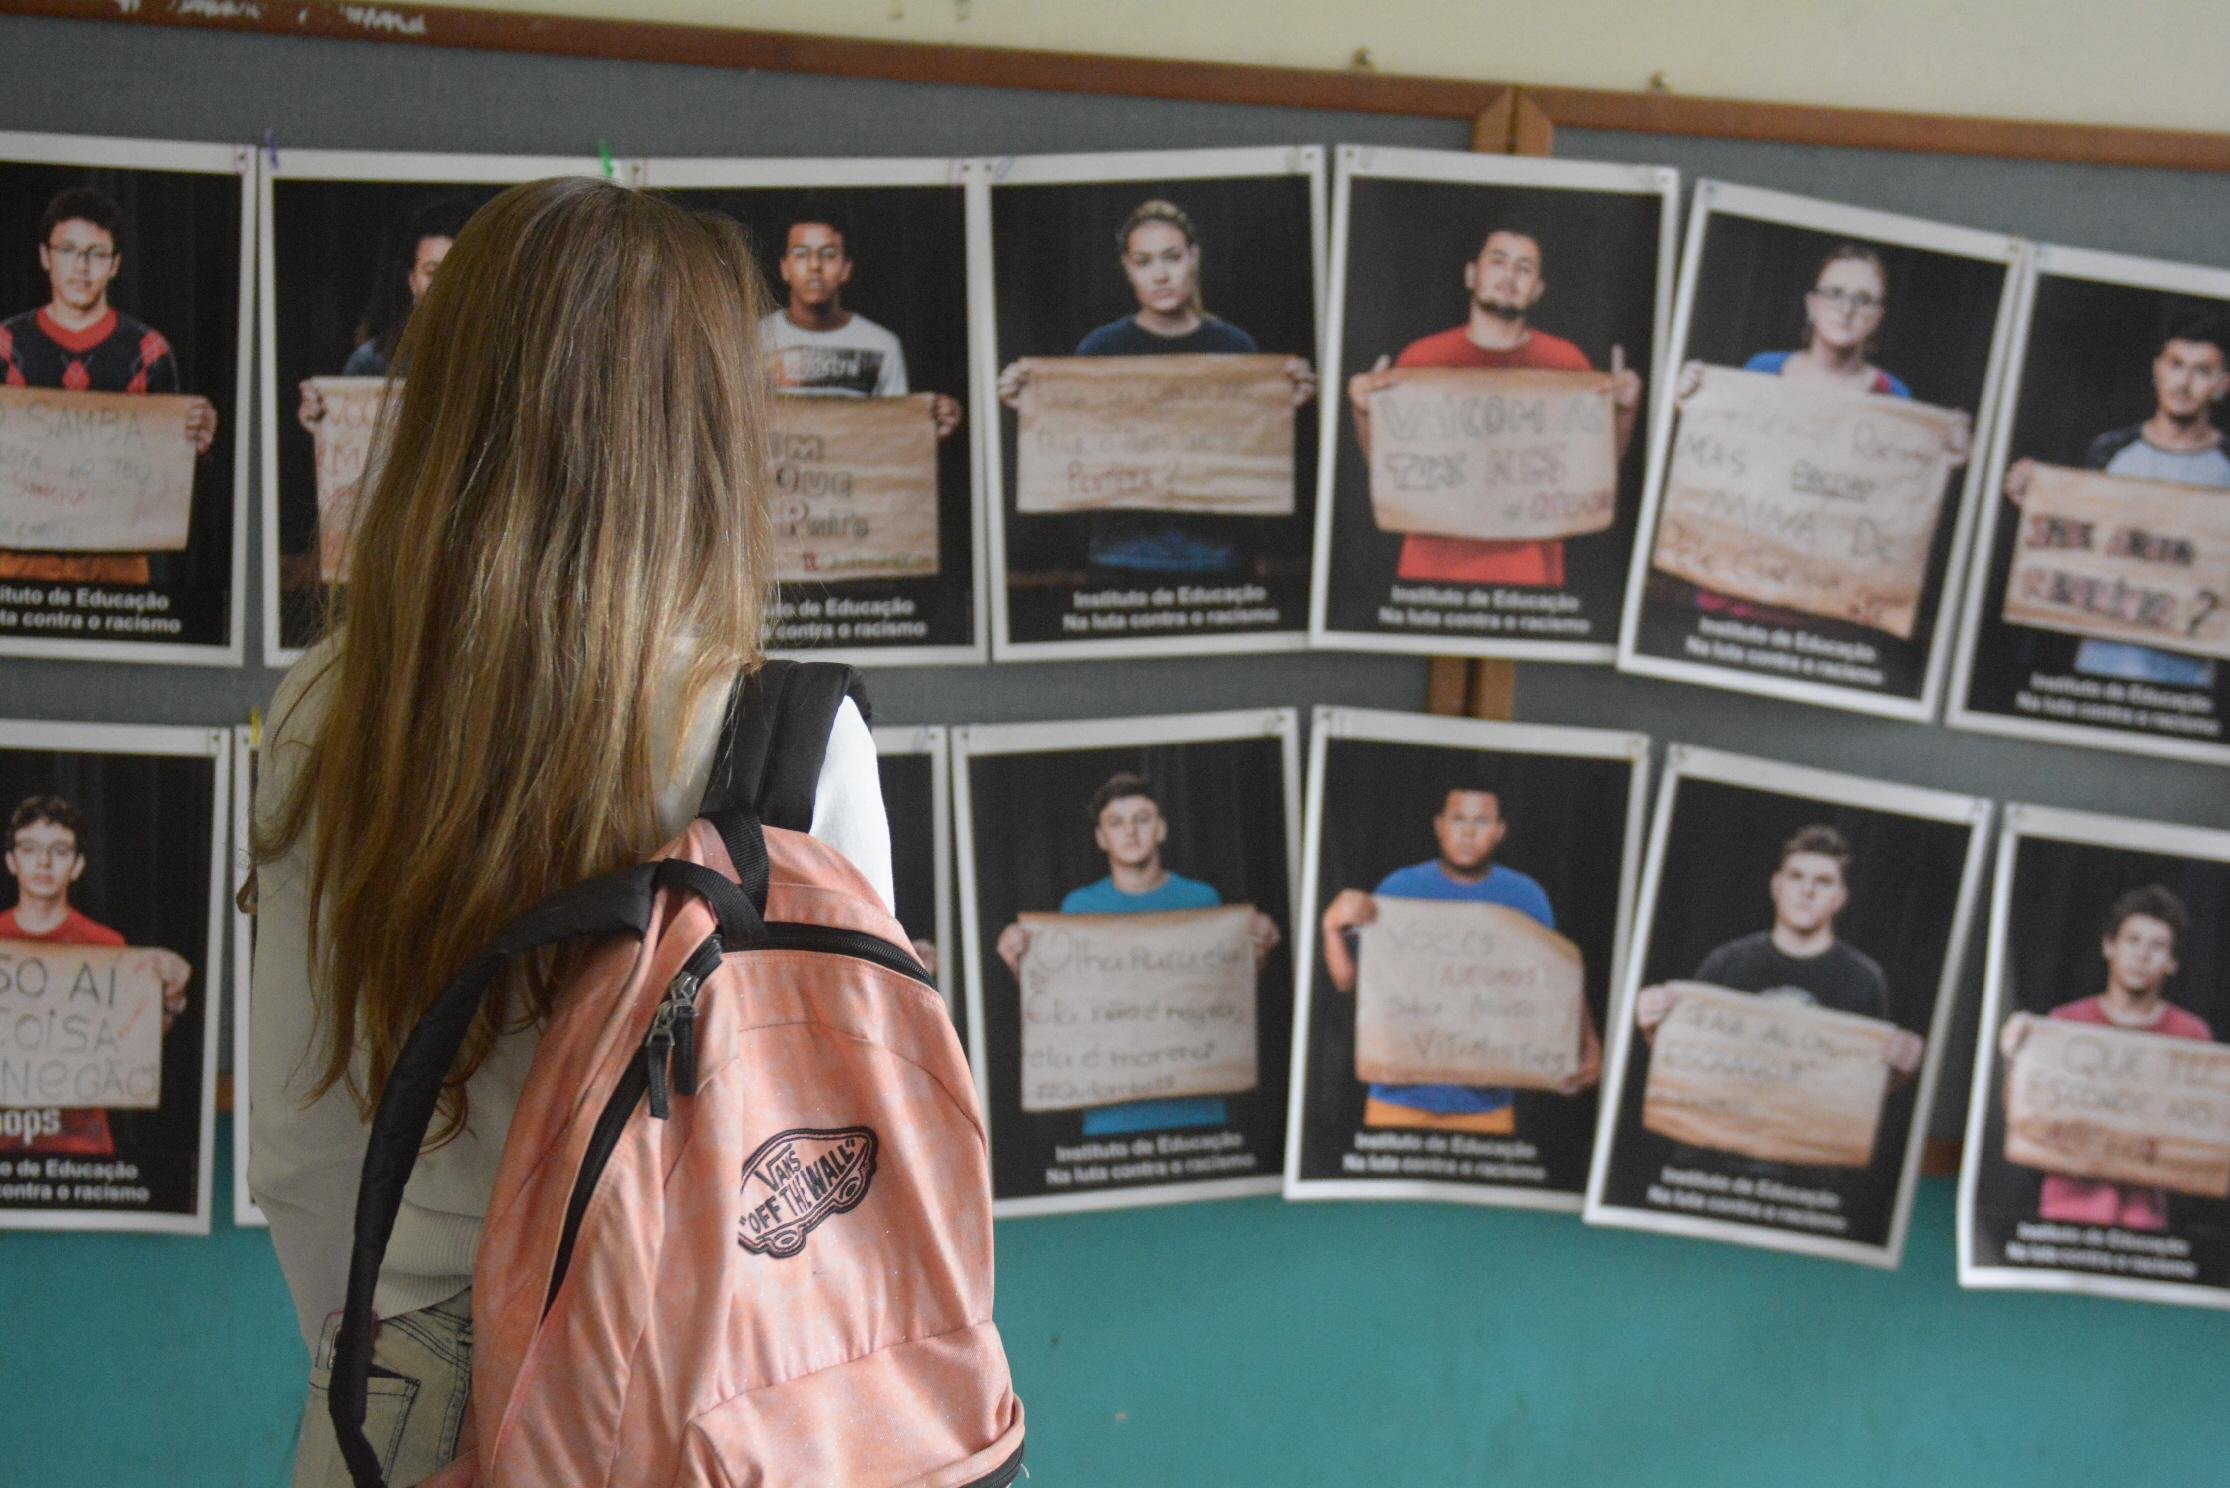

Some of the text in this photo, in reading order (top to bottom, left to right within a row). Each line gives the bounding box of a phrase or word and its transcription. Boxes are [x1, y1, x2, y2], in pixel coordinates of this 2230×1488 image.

[48, 587, 71, 608] de
[76, 588, 170, 612] Educação
[825, 598, 916, 618] Educação
[22, 610, 83, 629] contra
[88, 615, 100, 629] o
[105, 612, 182, 634] racismo
[775, 622, 834, 640] contra
[838, 623, 850, 639] o
[854, 620, 928, 639] racismo
[0, 1109, 62, 1146] ops
[16, 1160, 41, 1178] de
[45, 1159, 138, 1181] Educação
[754, 1143, 801, 1191] VANS
[0, 1183, 52, 1200] ontra
[74, 1183, 150, 1203] racismo
[779, 1175, 812, 1216] THE
